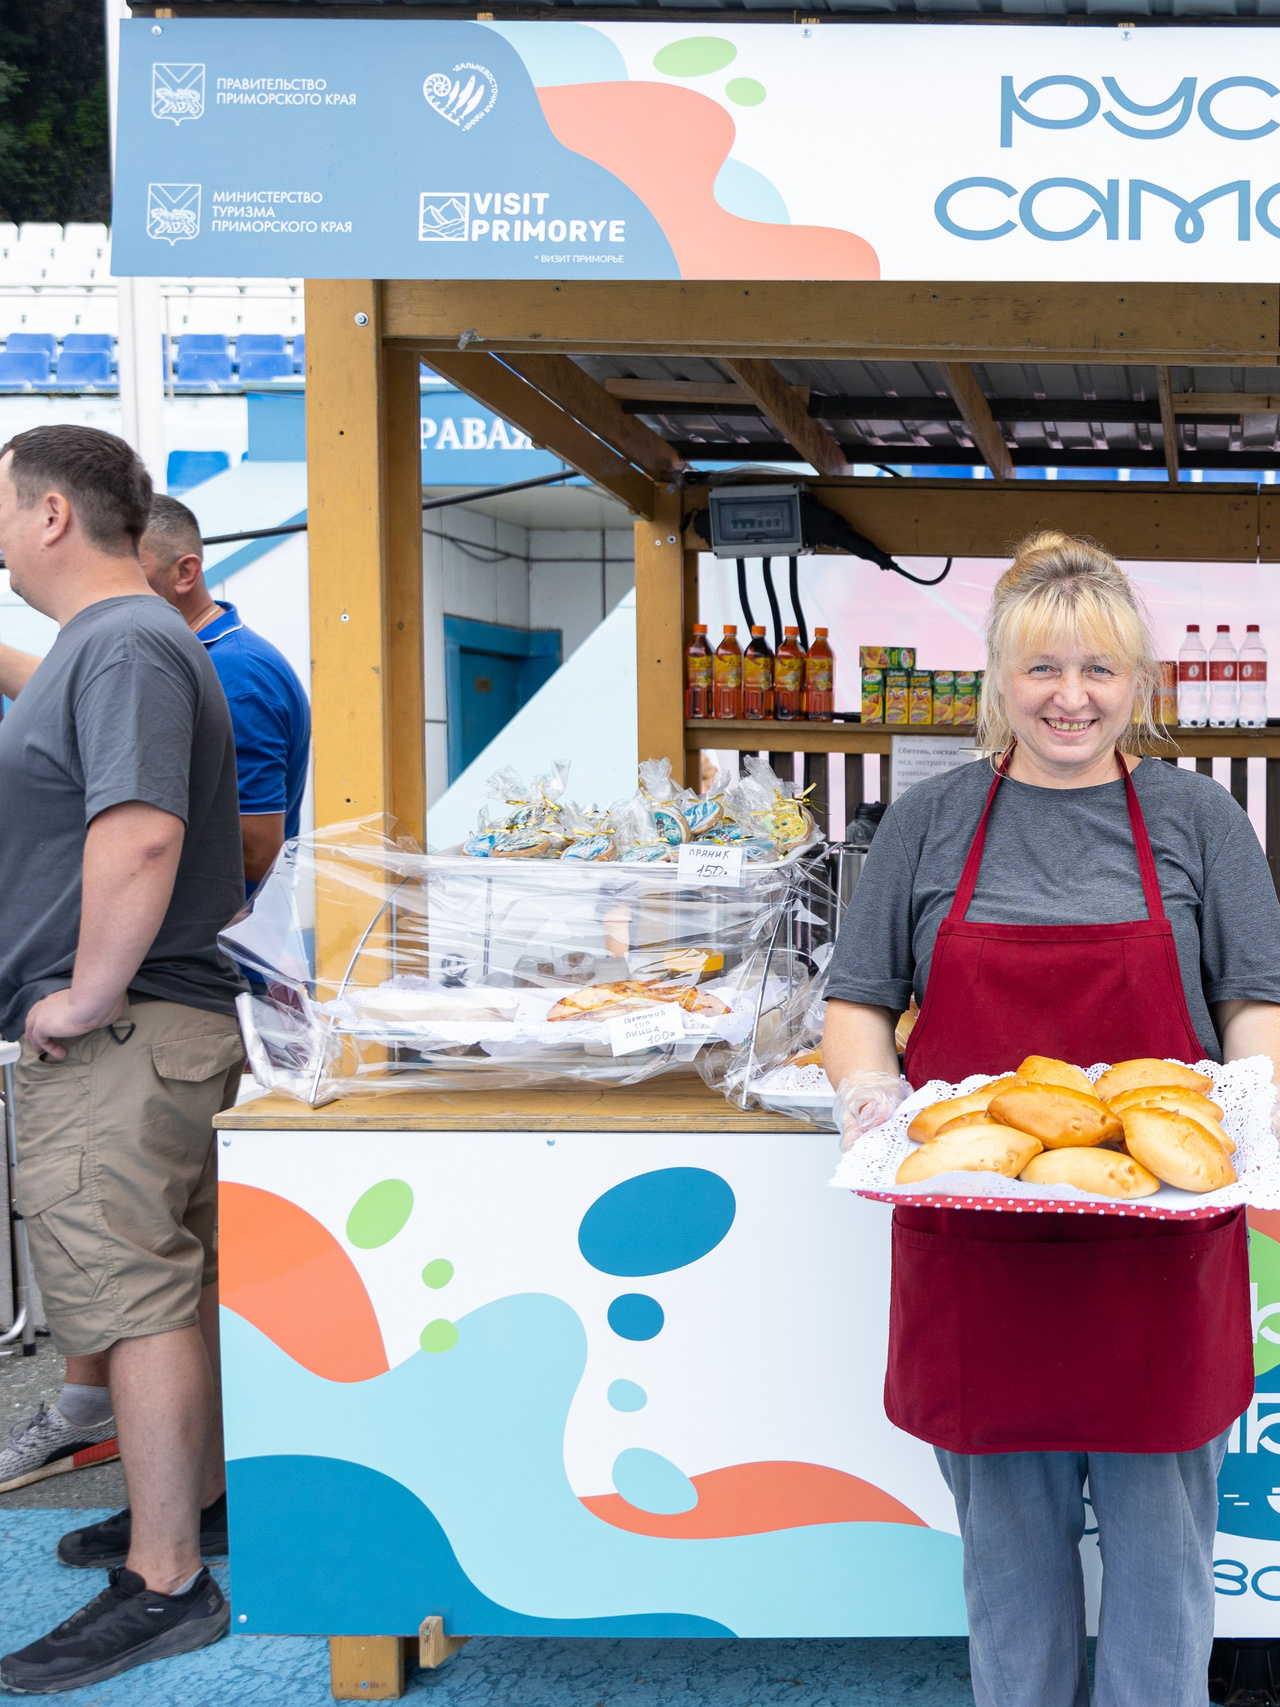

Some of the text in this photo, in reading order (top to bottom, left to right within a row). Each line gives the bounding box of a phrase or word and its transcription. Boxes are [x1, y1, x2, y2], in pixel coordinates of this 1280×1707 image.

[216, 77, 327, 91] ПРАВИТЕЛЬСТВО
[216, 92, 357, 106] ПРИМОРСКОГО КРАЯ
[212, 191, 323, 204] МИНИСТЕРСТВО
[473, 192, 550, 216] VISIT
[211, 205, 276, 218] ТУРИЗМА
[211, 220, 352, 233] ПРИМОРСКОГО КРАЯ
[471, 219, 626, 243] PRIMORYE
[540, 255, 624, 264] ВИЗИТ ПРИМОРЬЕ
[688, 848, 730, 859] ПРЯНИК
